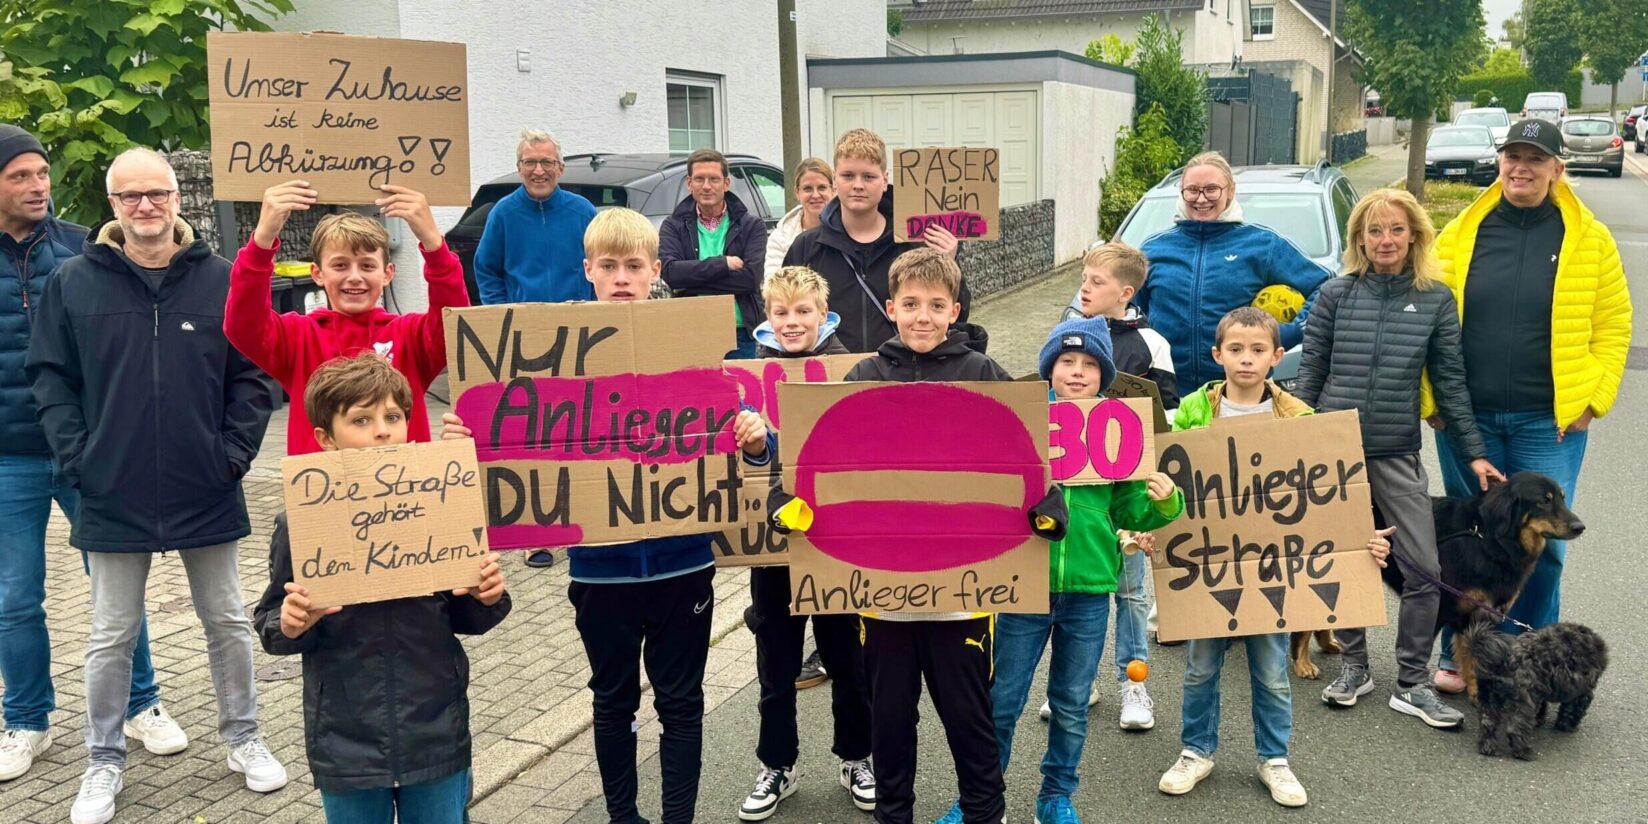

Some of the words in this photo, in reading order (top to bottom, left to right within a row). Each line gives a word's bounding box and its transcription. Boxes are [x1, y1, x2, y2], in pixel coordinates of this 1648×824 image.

[224, 57, 310, 98] Unser
[325, 58, 462, 102] Zuhause
[264, 108, 299, 128] ist
[311, 108, 380, 130] keine
[924, 185, 980, 214] Nein
[456, 308, 619, 382] Nur
[490, 376, 738, 458] Anlieger
[1049, 397, 1145, 481] 30
[291, 467, 368, 507] Die
[373, 460, 477, 504] Straße
[486, 466, 571, 529] DU
[607, 450, 744, 527] Nicht
[1157, 436, 1364, 525] Anlieger
[351, 501, 426, 541] gehört
[301, 547, 356, 579] den
[364, 526, 486, 575] Kindern!
[795, 569, 948, 612] Anlieger
[952, 570, 1020, 610] frei
